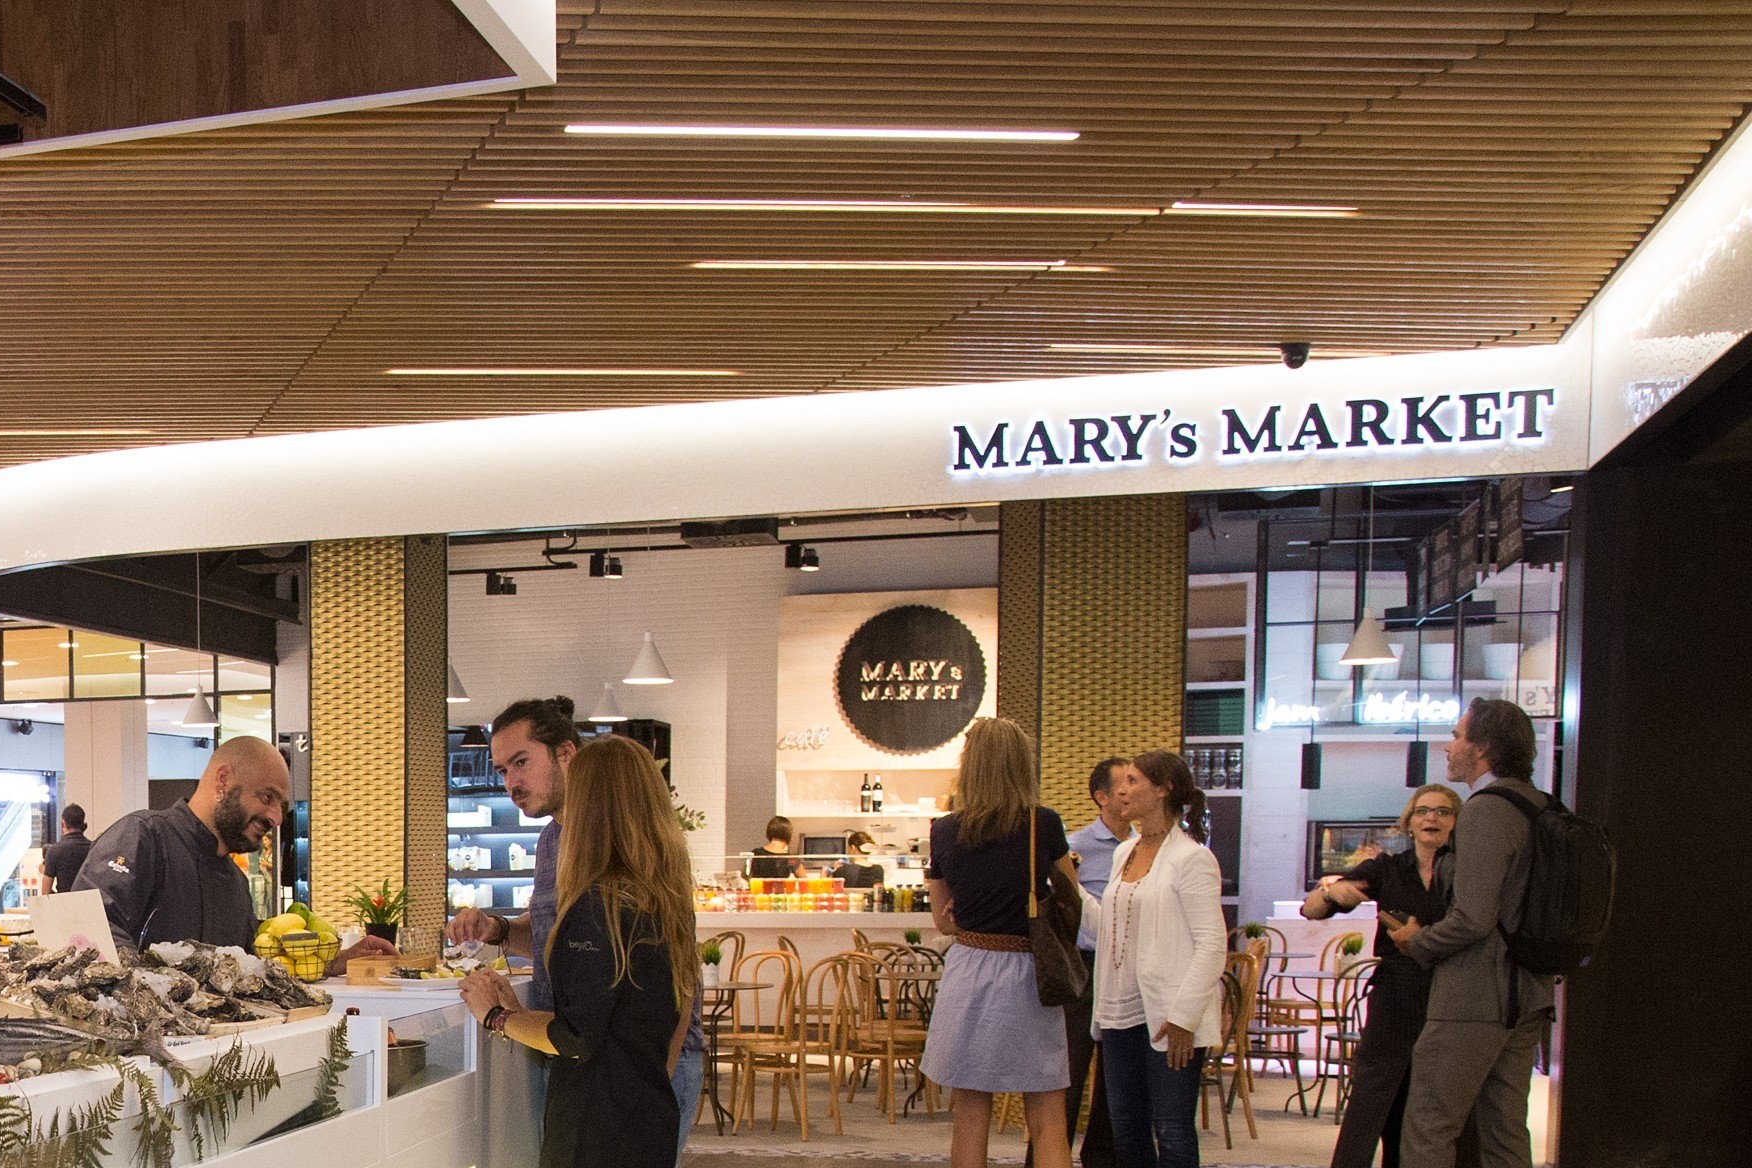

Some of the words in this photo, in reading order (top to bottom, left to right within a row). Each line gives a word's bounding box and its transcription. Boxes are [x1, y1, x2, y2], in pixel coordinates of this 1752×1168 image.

[952, 408, 1198, 471] MARY's
[1220, 388, 1555, 457] MARKET
[861, 684, 961, 701] MARKET
